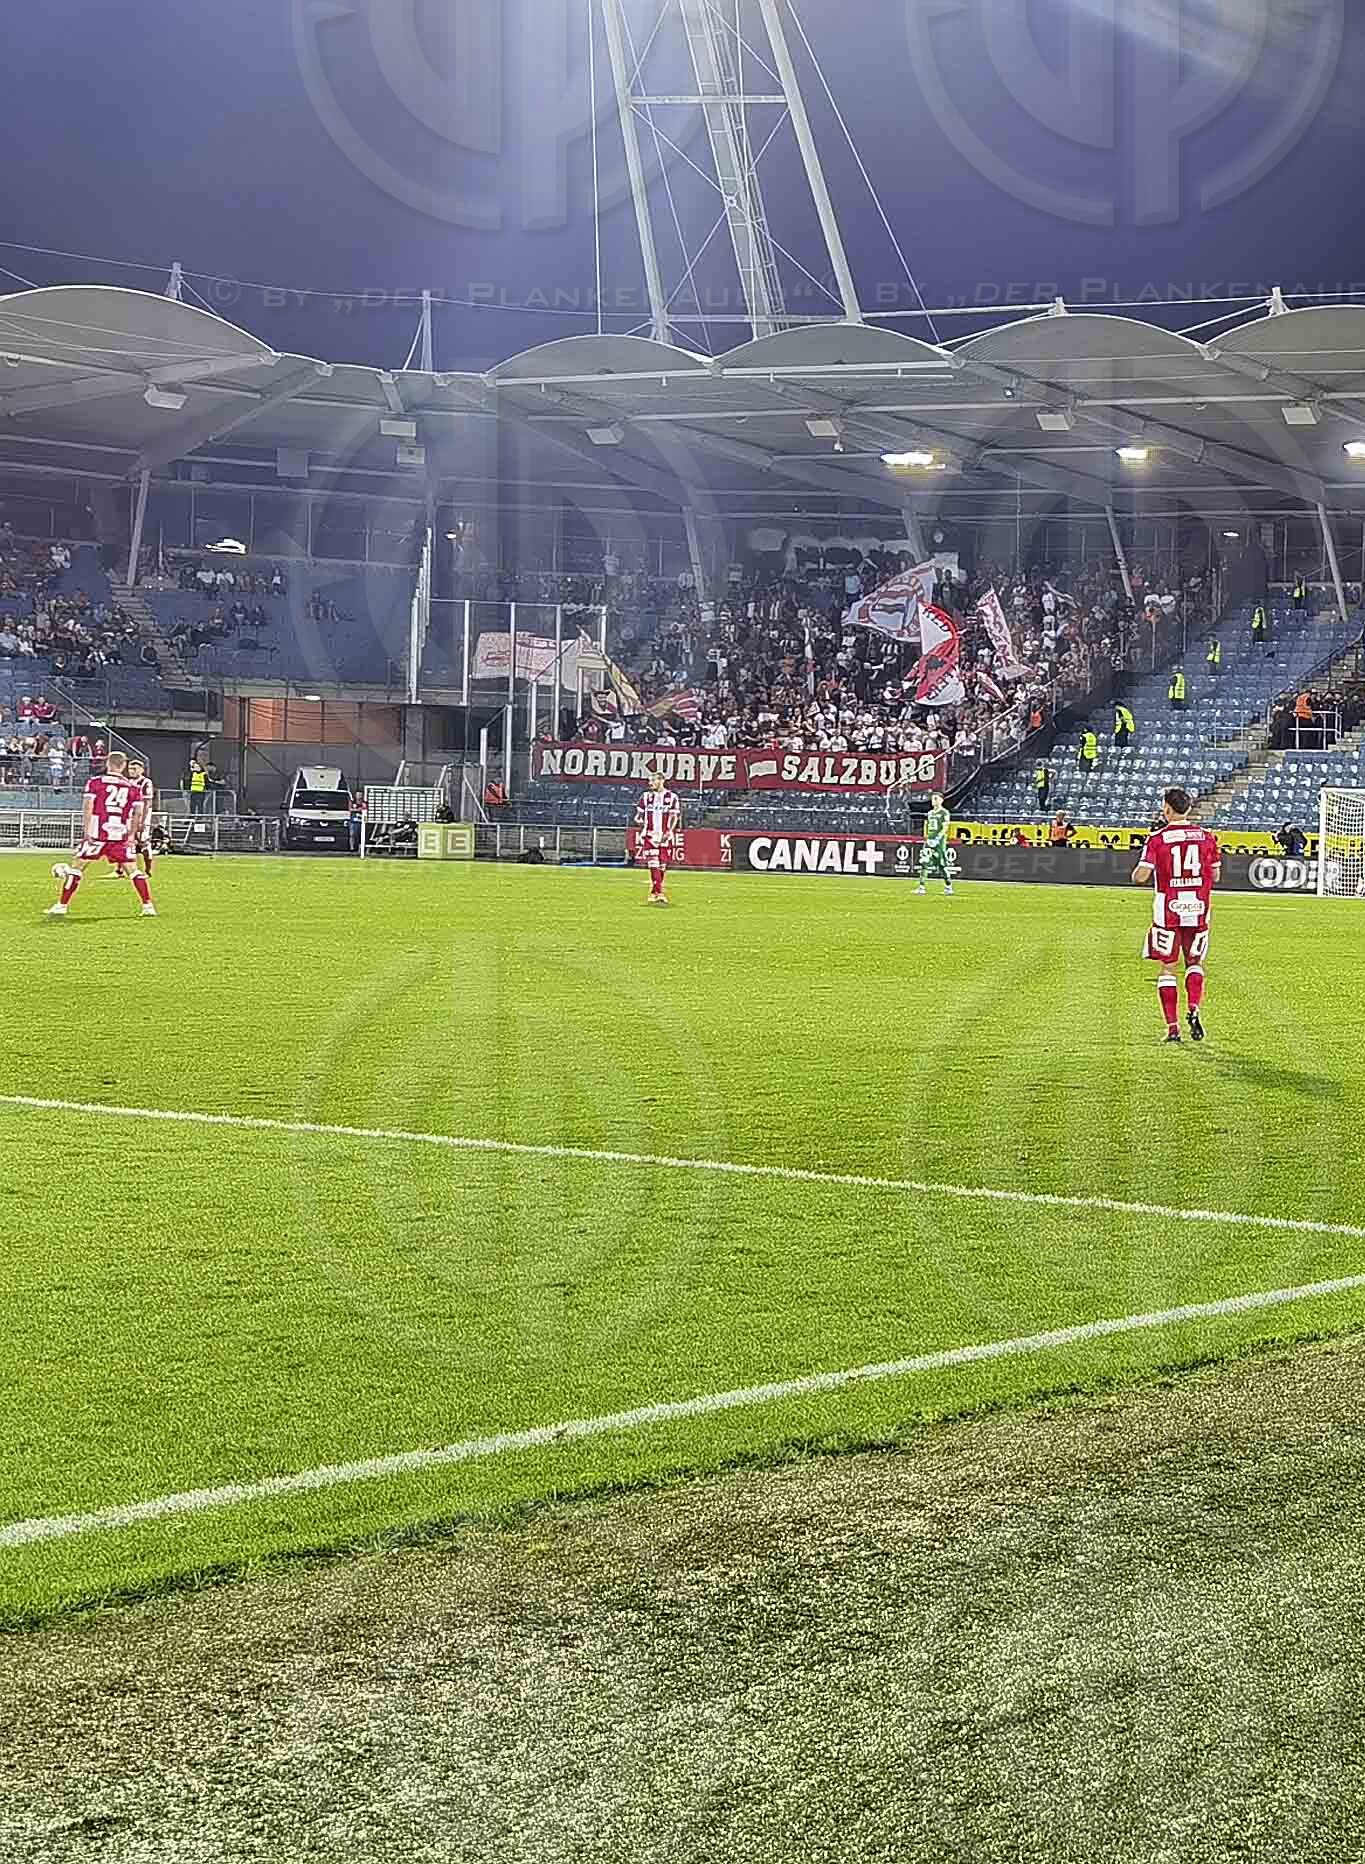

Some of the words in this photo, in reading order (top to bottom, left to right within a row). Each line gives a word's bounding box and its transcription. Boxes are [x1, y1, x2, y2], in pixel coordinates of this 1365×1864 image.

[541, 748, 737, 781] NORDKURVE
[781, 755, 936, 785] SALZBURG
[104, 785, 129, 808] 24
[748, 836, 885, 875] CANAL+
[1170, 844, 1202, 878] 14
